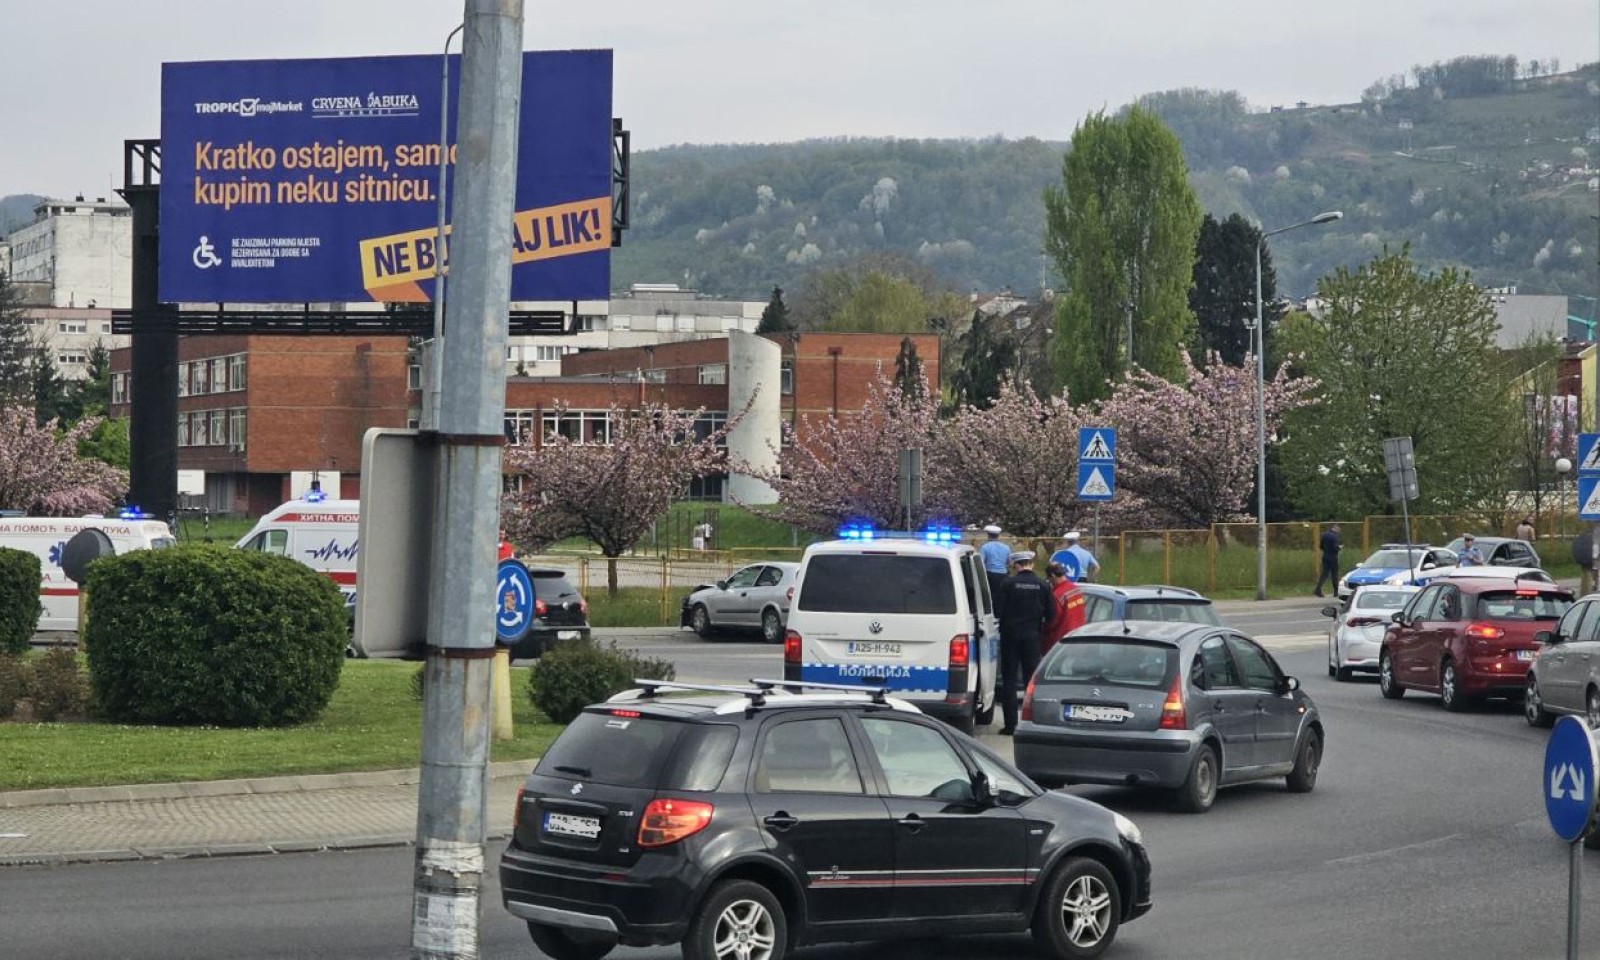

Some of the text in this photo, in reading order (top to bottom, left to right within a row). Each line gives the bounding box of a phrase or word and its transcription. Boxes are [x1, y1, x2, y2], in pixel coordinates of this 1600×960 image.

[195, 101, 303, 114] TROPIC mojMarket
[312, 97, 362, 109] CRVENA
[195, 140, 277, 171] Kratko
[282, 139, 390, 174] ostajem,
[194, 172, 436, 211] kupim neku sitnicu.
[231, 238, 240, 247] NE
[271, 237, 296, 247] PARKING
[296, 237, 321, 247] MJESTA
[373, 241, 411, 278] NE
[546, 207, 603, 249] LIK!
[301, 248, 310, 257] SA
[838, 666, 911, 678] ПОЛИЦИЈА
